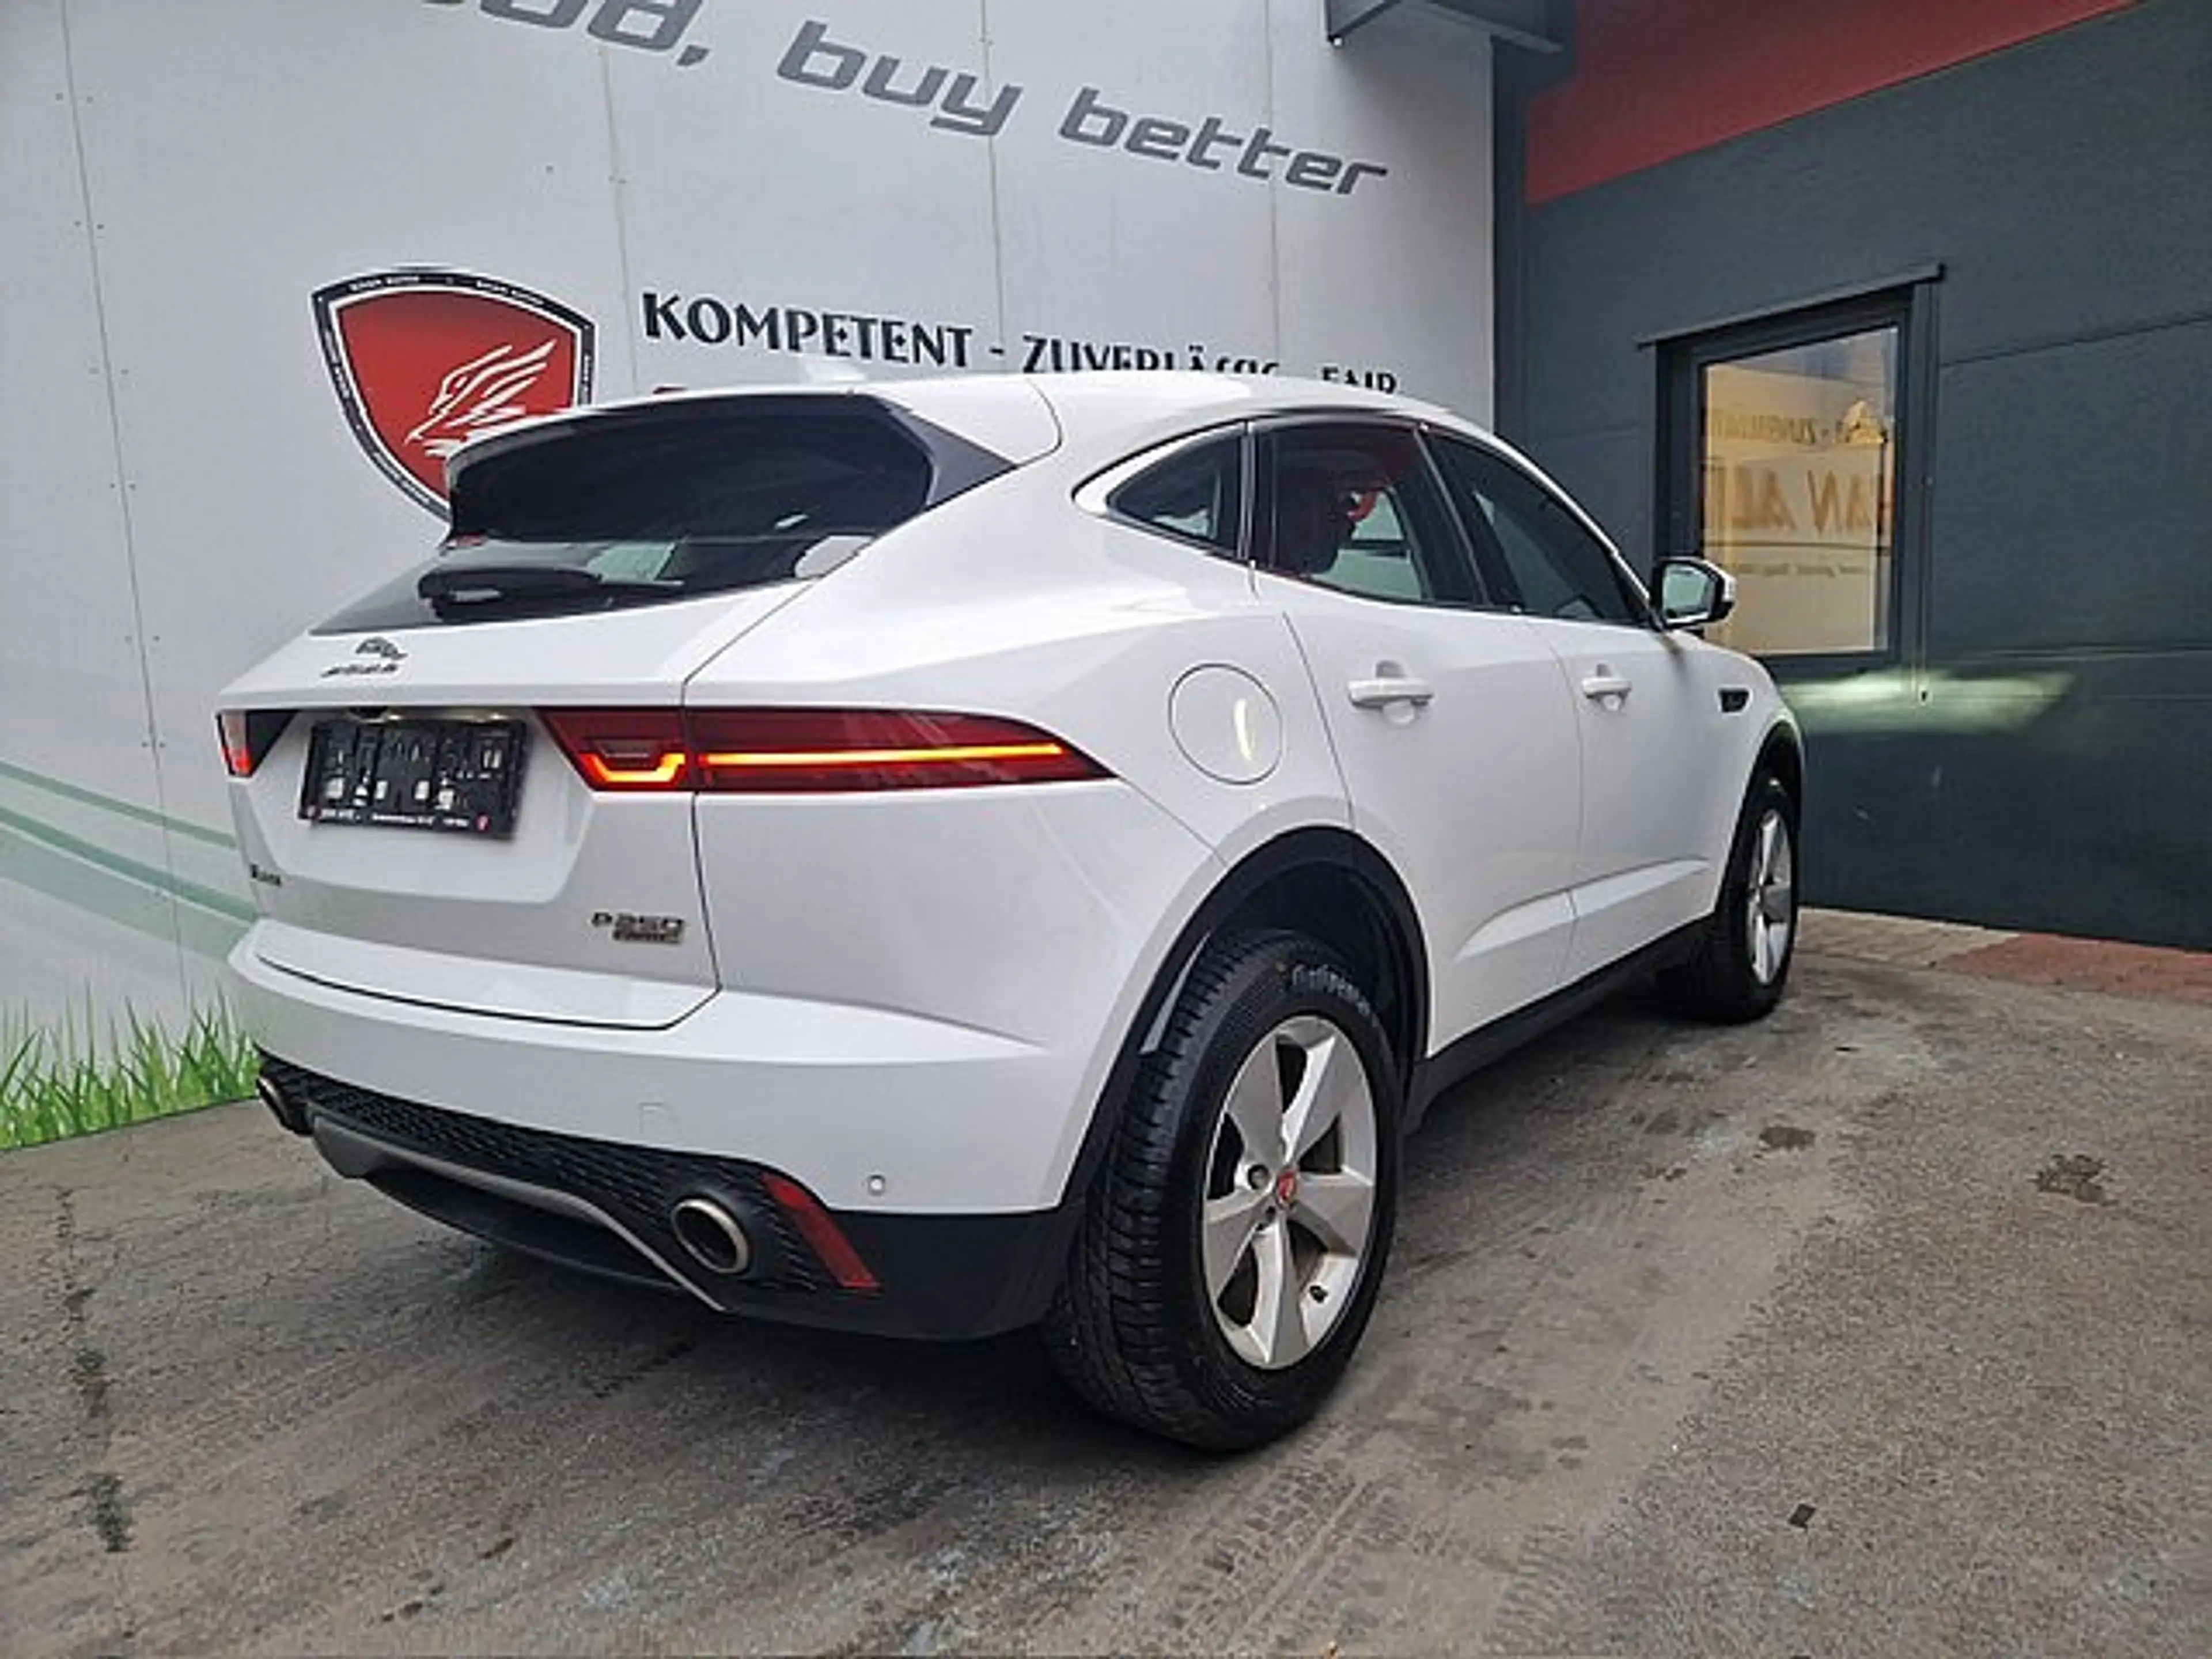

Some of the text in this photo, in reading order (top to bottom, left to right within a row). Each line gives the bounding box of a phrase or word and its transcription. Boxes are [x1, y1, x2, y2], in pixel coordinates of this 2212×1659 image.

[777, 20, 1024, 135] buy
[1059, 88, 1388, 195] better
[643, 293, 972, 368] KOMPETENT
